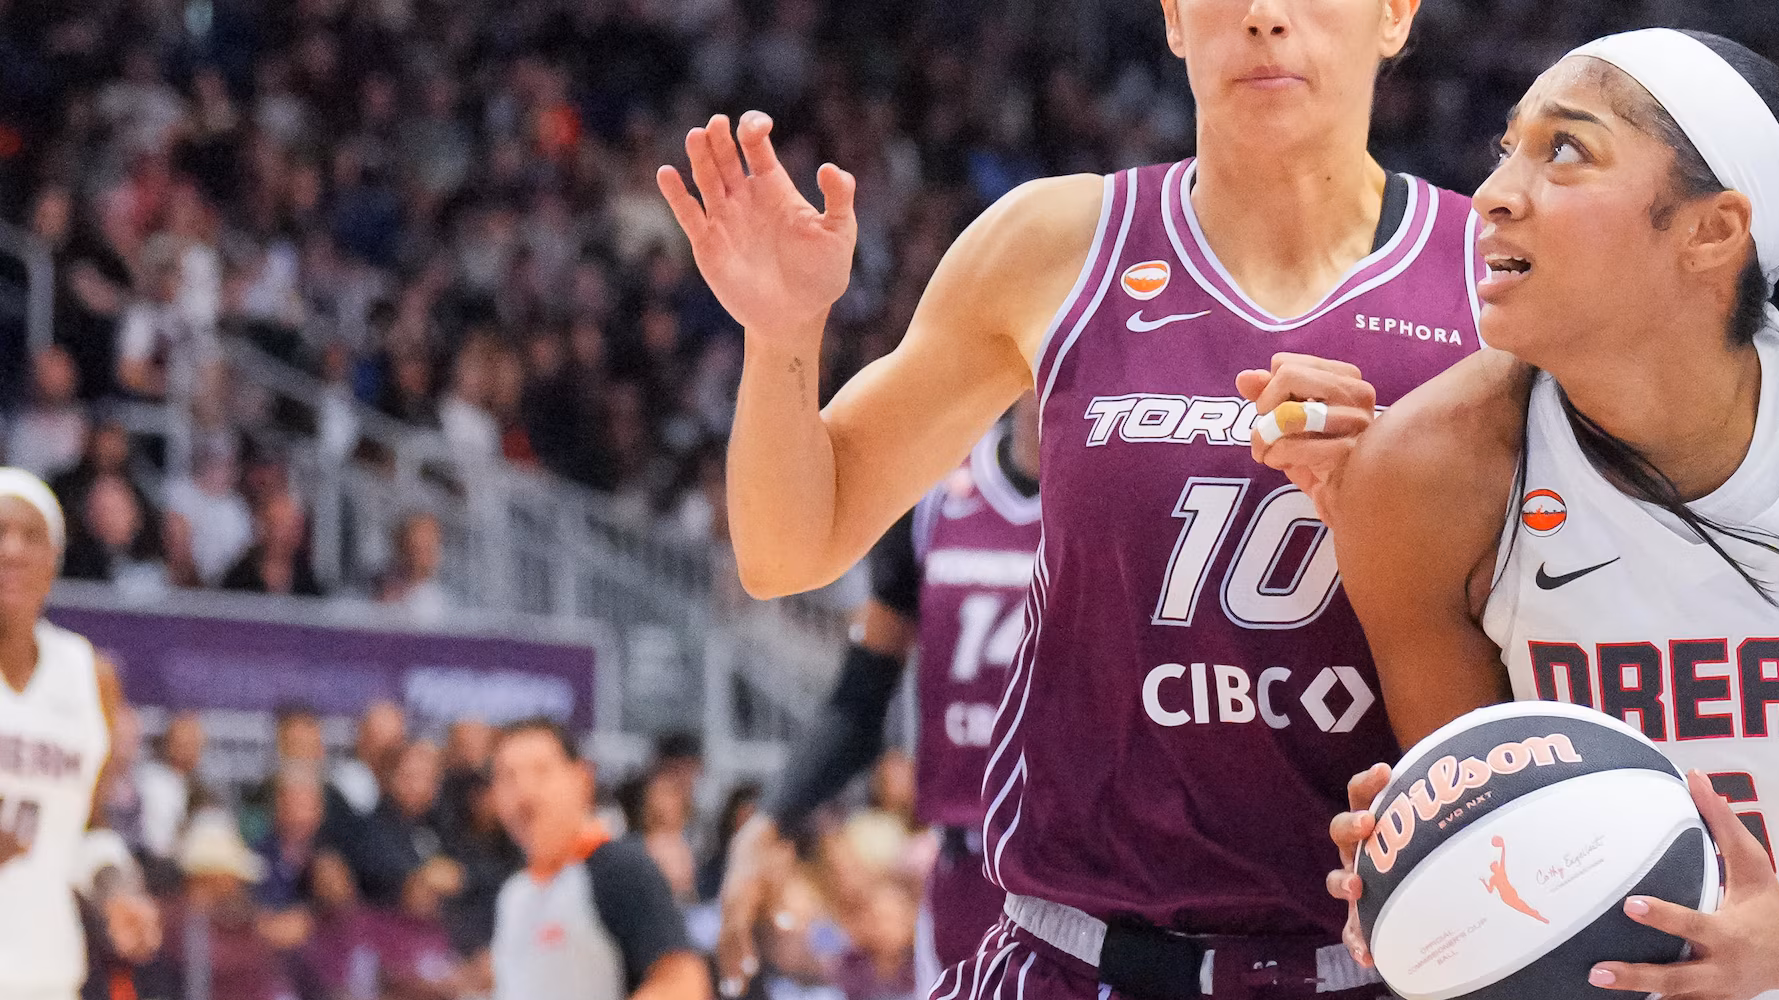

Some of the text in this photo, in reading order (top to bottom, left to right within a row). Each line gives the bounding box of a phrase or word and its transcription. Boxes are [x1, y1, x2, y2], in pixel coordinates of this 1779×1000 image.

[1355, 313, 1462, 346] SEPHORA
[1151, 477, 1342, 630] 10
[1142, 662, 1292, 730] CIBC
[1364, 733, 1583, 874] Wilson
[1465, 790, 1493, 810] NXT
